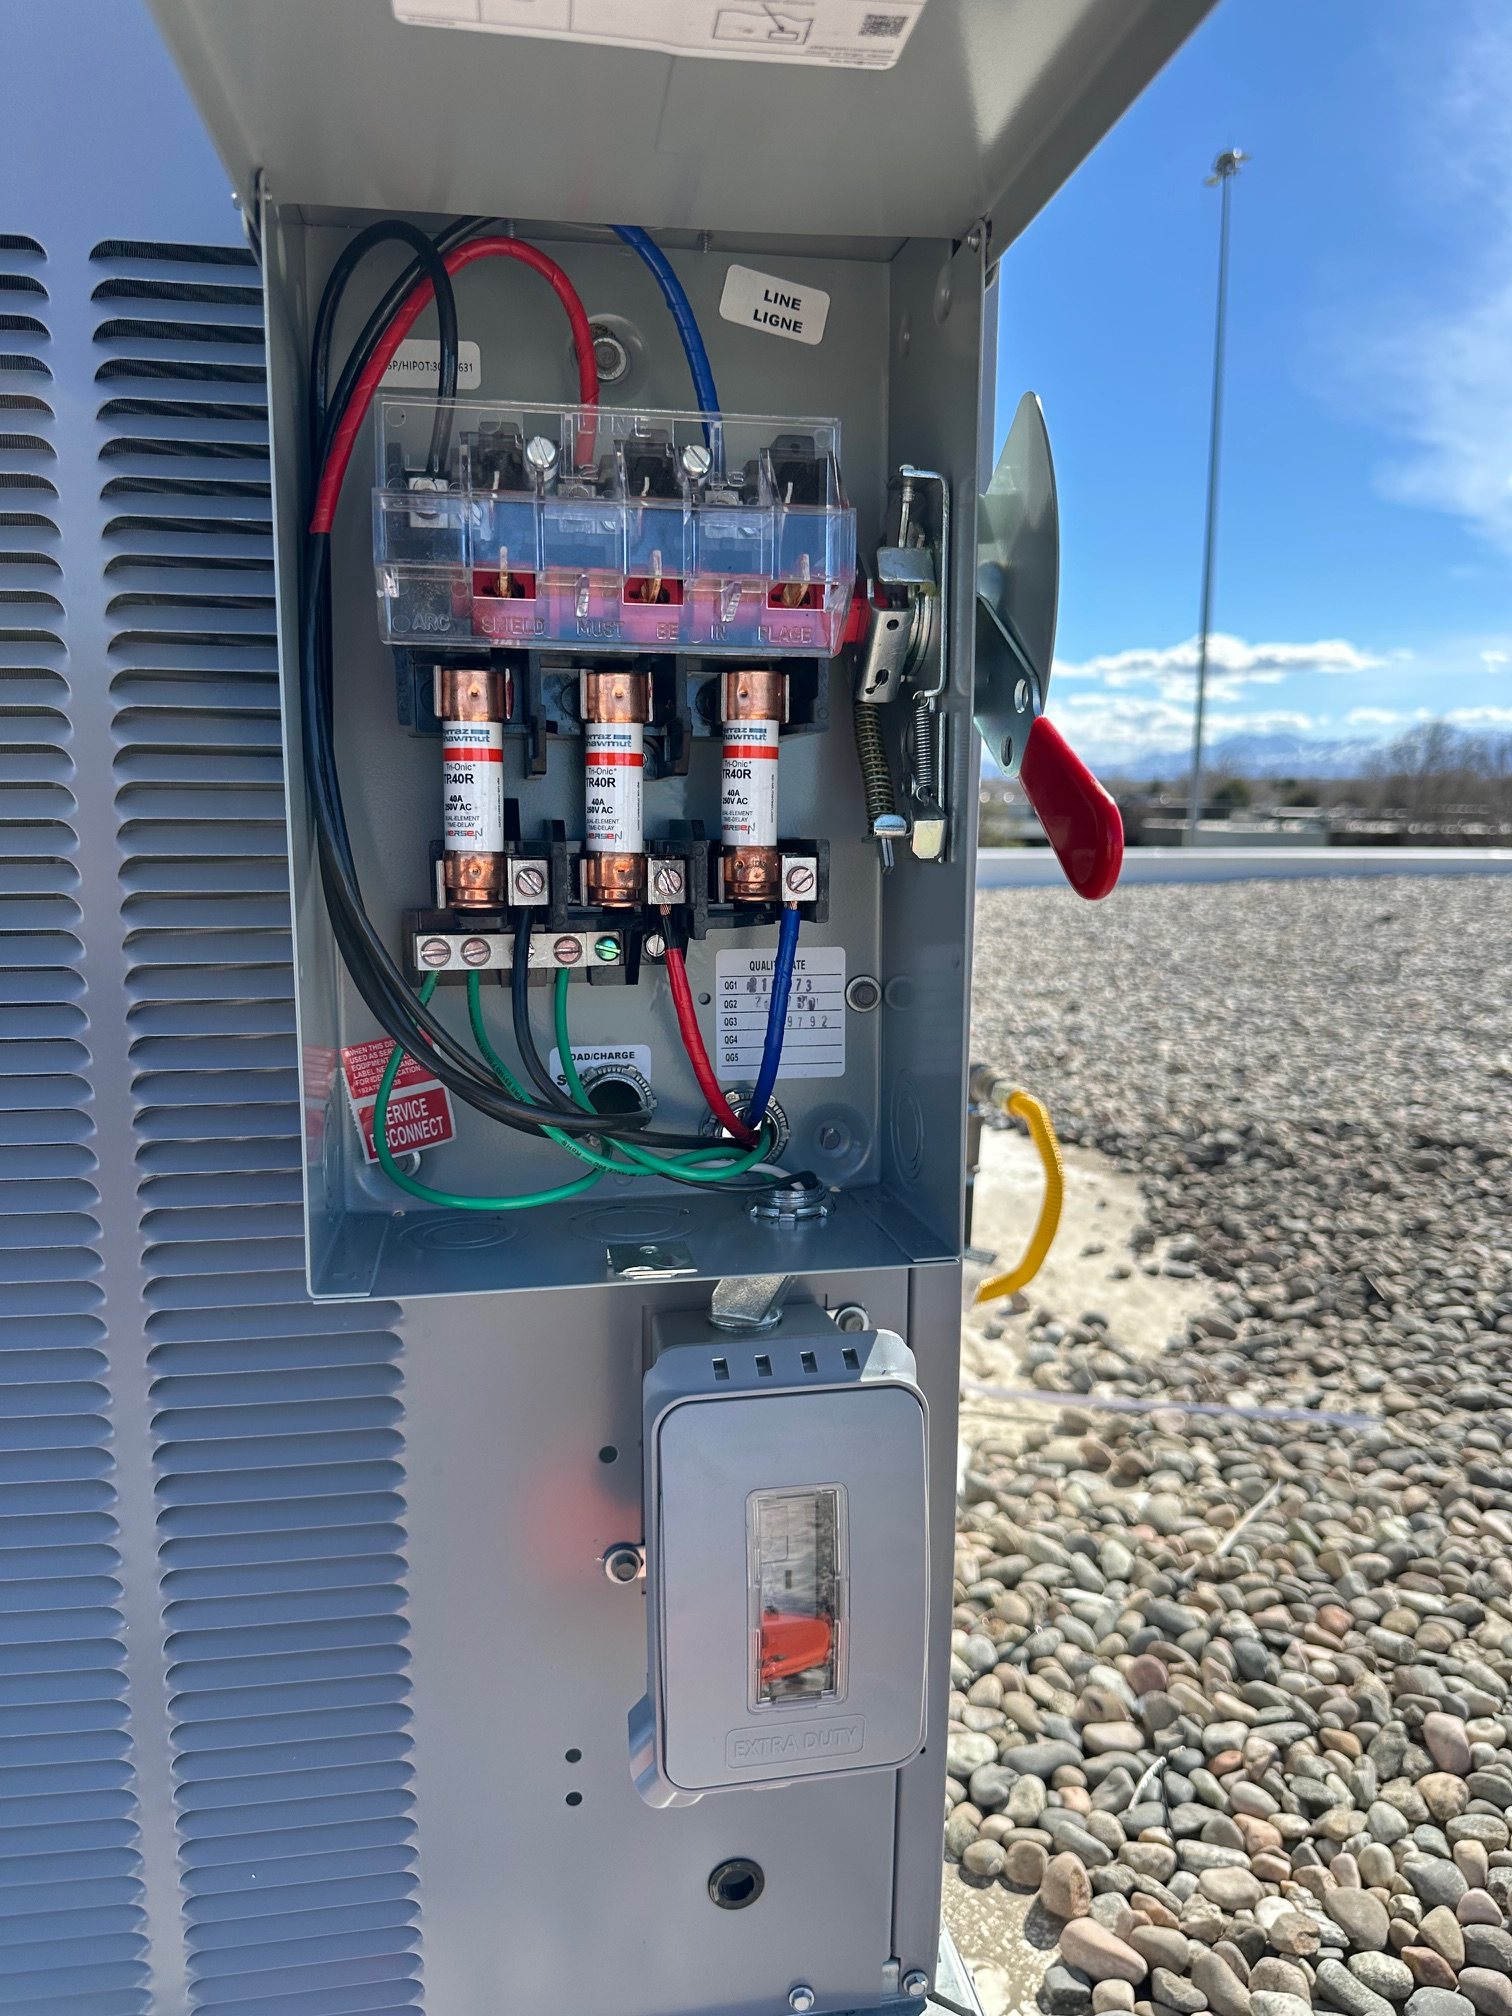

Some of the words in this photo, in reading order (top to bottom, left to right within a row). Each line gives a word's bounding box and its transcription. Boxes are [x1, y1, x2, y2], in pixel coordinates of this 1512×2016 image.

[763, 289, 802, 311] LINE
[752, 309, 804, 334] LIGNE
[412, 612, 450, 632] ARC
[481, 614, 545, 636] SHIELD
[576, 617, 625, 638] MUST
[656, 622, 679, 641] BE
[709, 623, 728, 642] IN
[756, 624, 813, 644] PLACE
[444, 773, 474, 785] TR40R
[722, 768, 752, 780] TR40R
[586, 777, 616, 788] TR40R
[449, 794, 463, 802] 40A
[727, 789, 740, 797] 40A
[591, 798, 605, 806] 40A
[736, 797, 748, 805] AC
[459, 803, 472, 811] AC
[601, 806, 614, 814] AC
[724, 980, 738, 990] QG1
[724, 999, 738, 1009] QG2
[724, 1017, 738, 1027] QG3
[724, 1035, 738, 1045] QG4
[345, 1046, 368, 1058] WHEN
[369, 1043, 384, 1052] THIS
[349, 1054, 368, 1064] USED
[369, 1051, 378, 1059] AS
[571, 1051, 636, 1061] OAD/CHARGE
[725, 1053, 739, 1062] QG5
[351, 1057, 389, 1072] EQUIPMENT
[353, 1068, 375, 1079] LABEL
[355, 1077, 370, 1086] FOR
[385, 1097, 429, 1126] ERVICE
[370, 1115, 444, 1152] SCONNECT
[734, 1734, 799, 1759] EXTRA
[803, 1725, 859, 1750] DUTY
